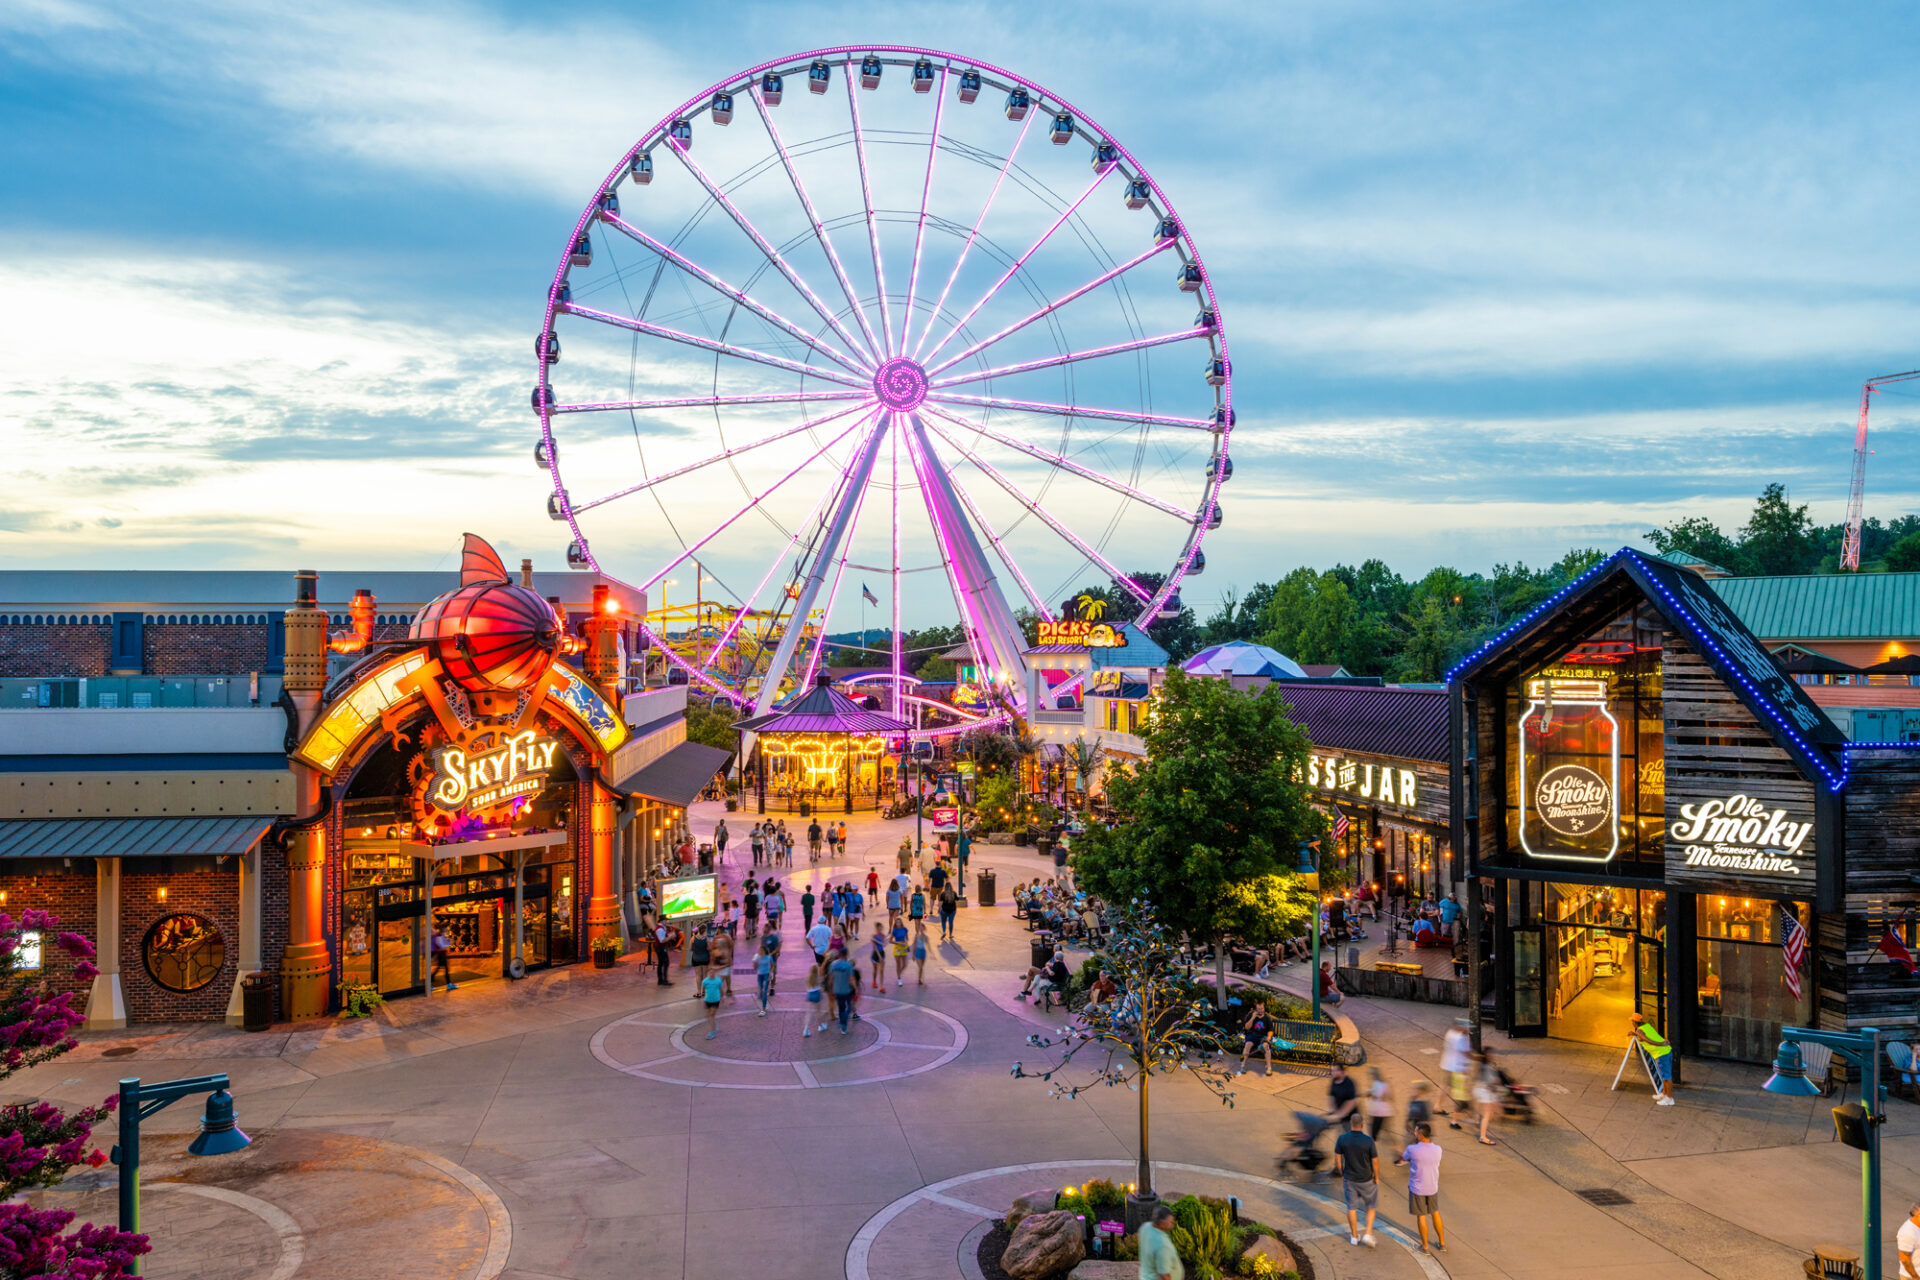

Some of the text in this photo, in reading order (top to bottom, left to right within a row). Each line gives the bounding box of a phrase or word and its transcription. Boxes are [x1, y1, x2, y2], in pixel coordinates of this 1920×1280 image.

[1038, 620, 1091, 636] DICK'S
[1038, 635, 1056, 645] LAST
[472, 779, 539, 807] SOAR AMERICA
[1339, 766, 1356, 784] THE
[1360, 764, 1416, 806] JAR
[1539, 780, 1609, 806] Smoky
[1562, 775, 1587, 788] Ole
[1547, 805, 1606, 818] Moonshine
[1725, 794, 1770, 820] Ole
[1671, 800, 1813, 856] Smoky
[1684, 845, 1800, 874] Moonshine
[1714, 843, 1757, 856] Tennessee
